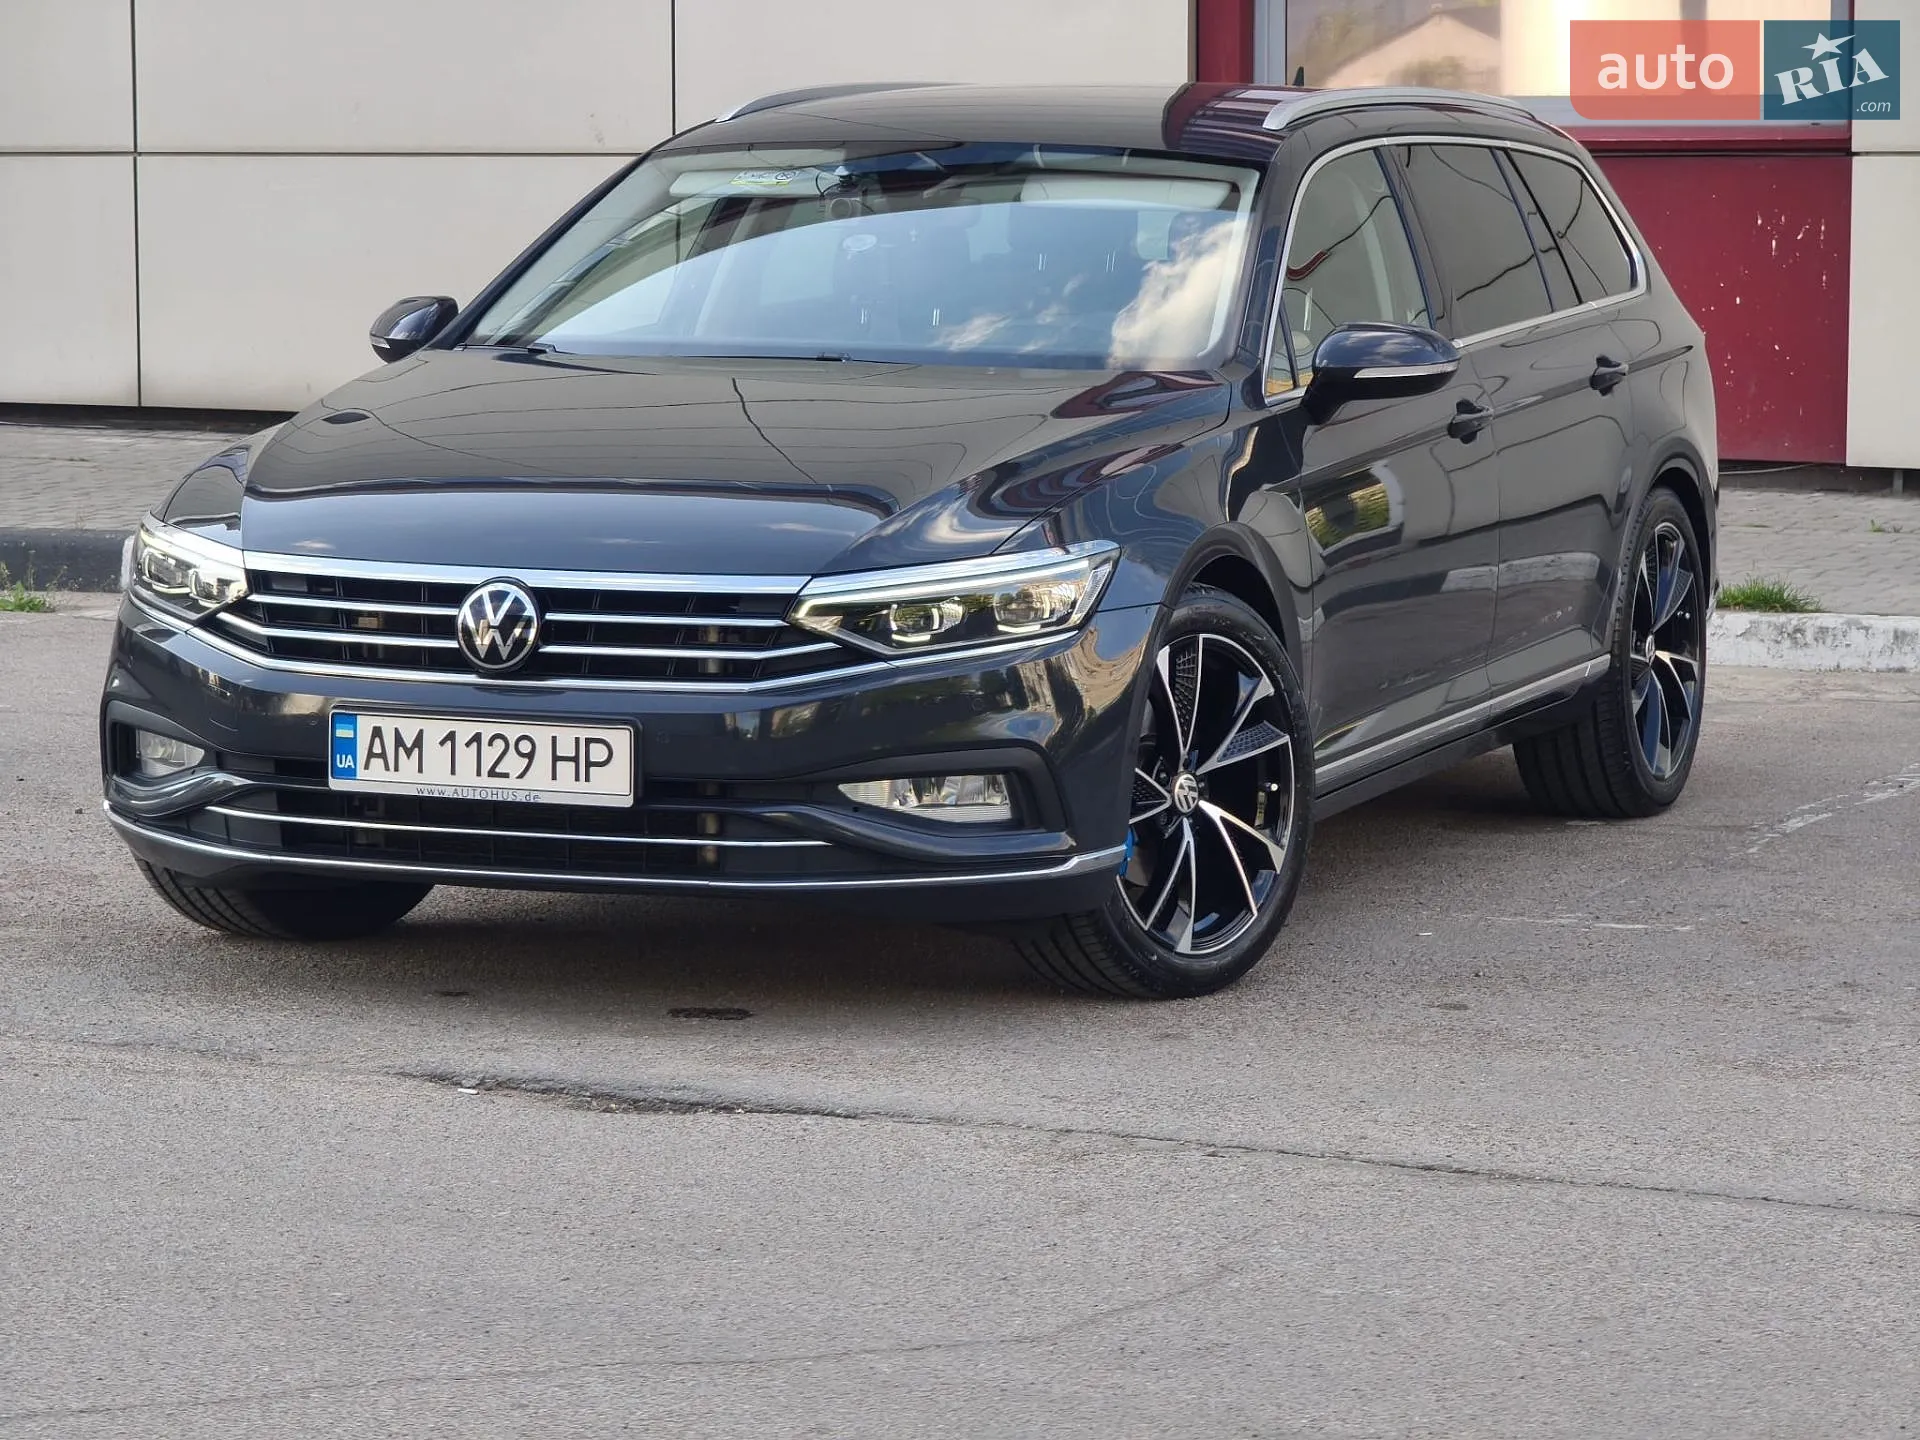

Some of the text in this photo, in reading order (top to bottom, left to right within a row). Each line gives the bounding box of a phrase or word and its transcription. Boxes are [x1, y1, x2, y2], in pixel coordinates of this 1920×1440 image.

[336, 753, 355, 769] UA
[363, 725, 614, 783] AM 1129 HP
